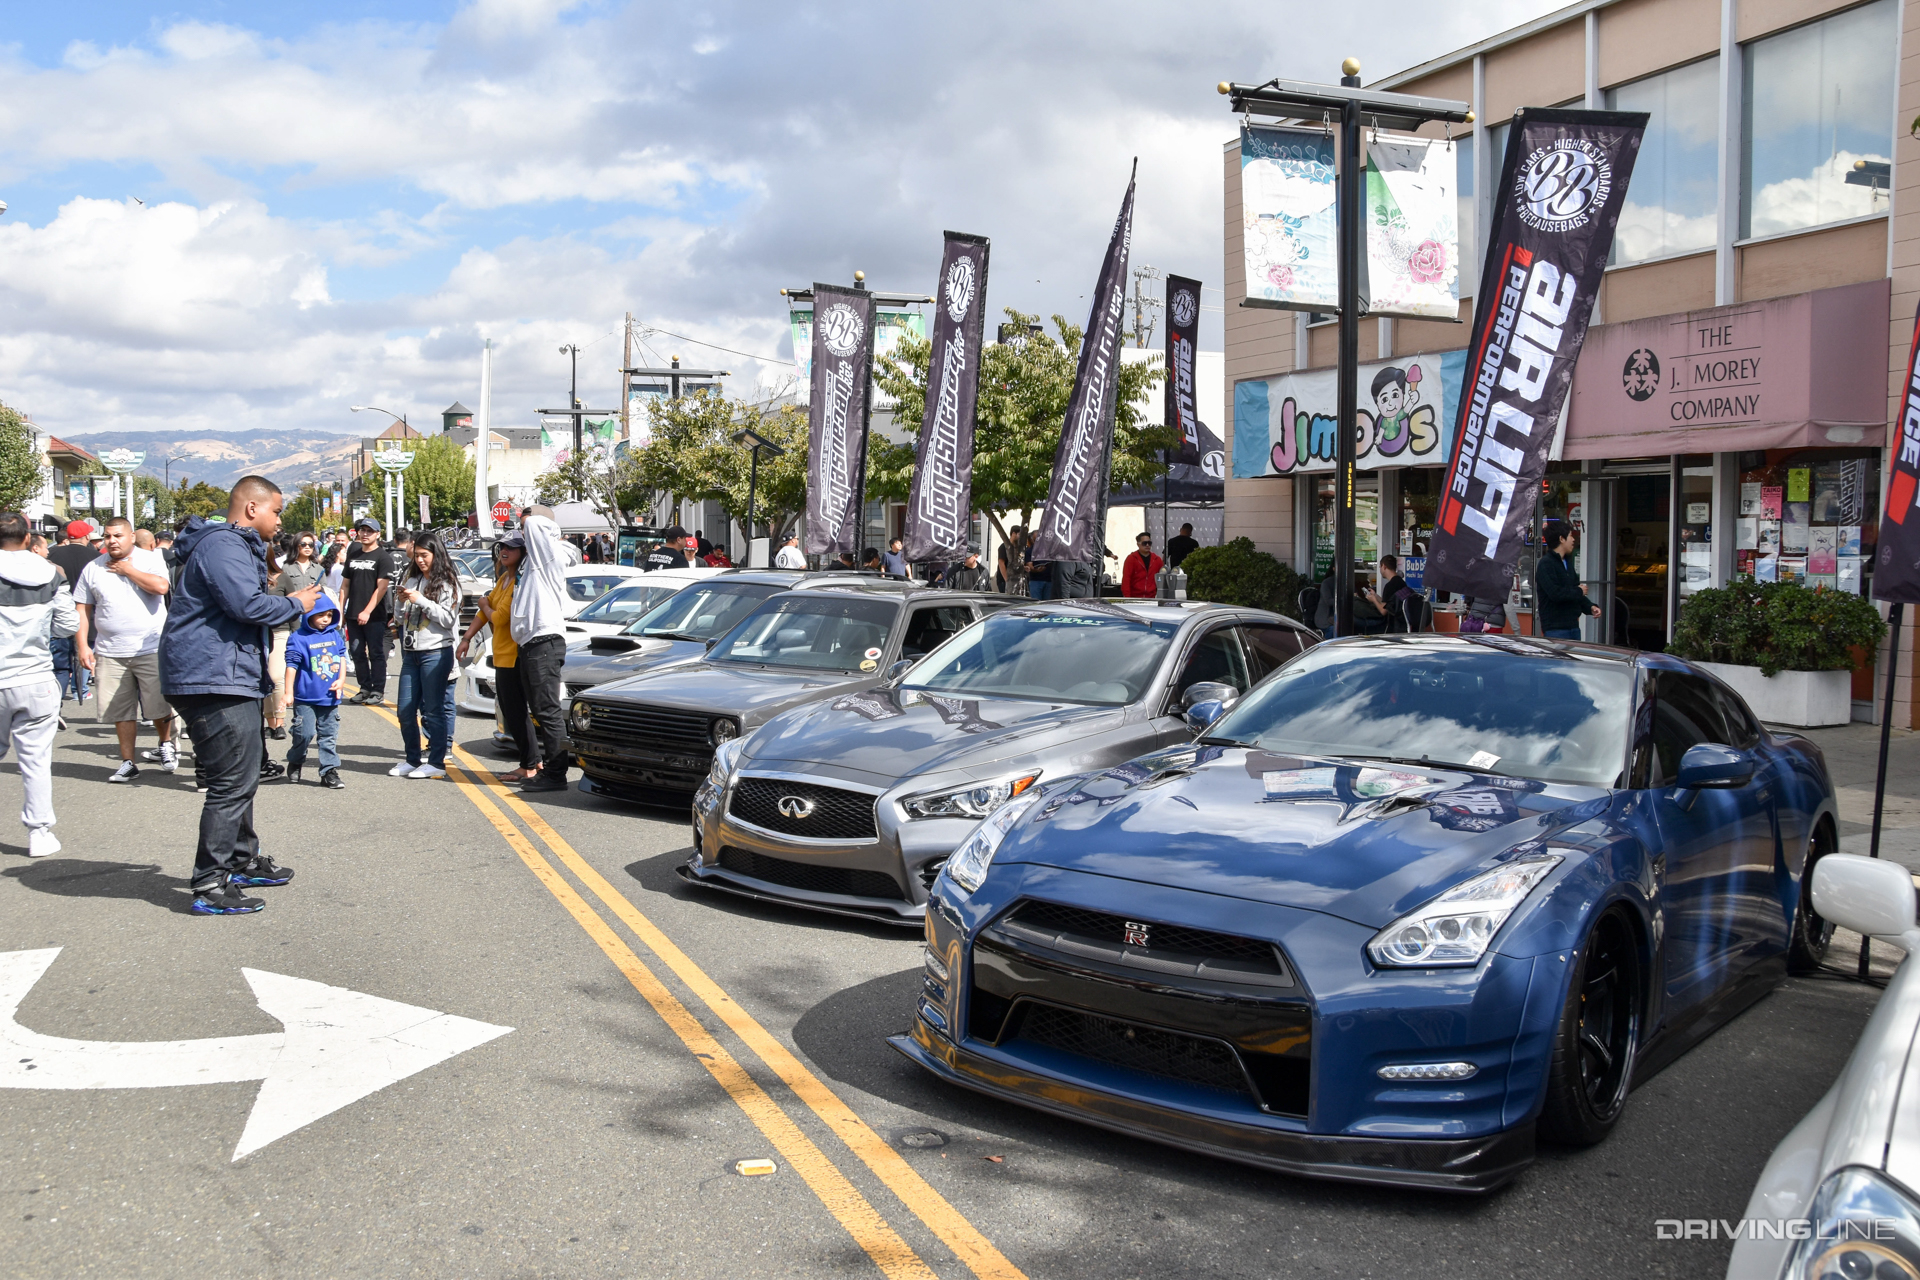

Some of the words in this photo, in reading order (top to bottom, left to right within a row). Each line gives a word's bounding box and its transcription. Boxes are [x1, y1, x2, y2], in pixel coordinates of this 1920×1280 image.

[1514, 175, 1524, 197] LOW
[1521, 147, 1546, 173] CARS
[1554, 138, 1592, 154] HIGHER
[1589, 147, 1613, 208] STANDARDS
[1515, 204, 1590, 233] #BECAUSEBAGS
[1698, 325, 1733, 349] THE
[1670, 367, 1680, 390] J.
[1694, 357, 1761, 384] MOREY
[1670, 394, 1761, 421] COMPANY
[494, 507, 509, 517] STO
